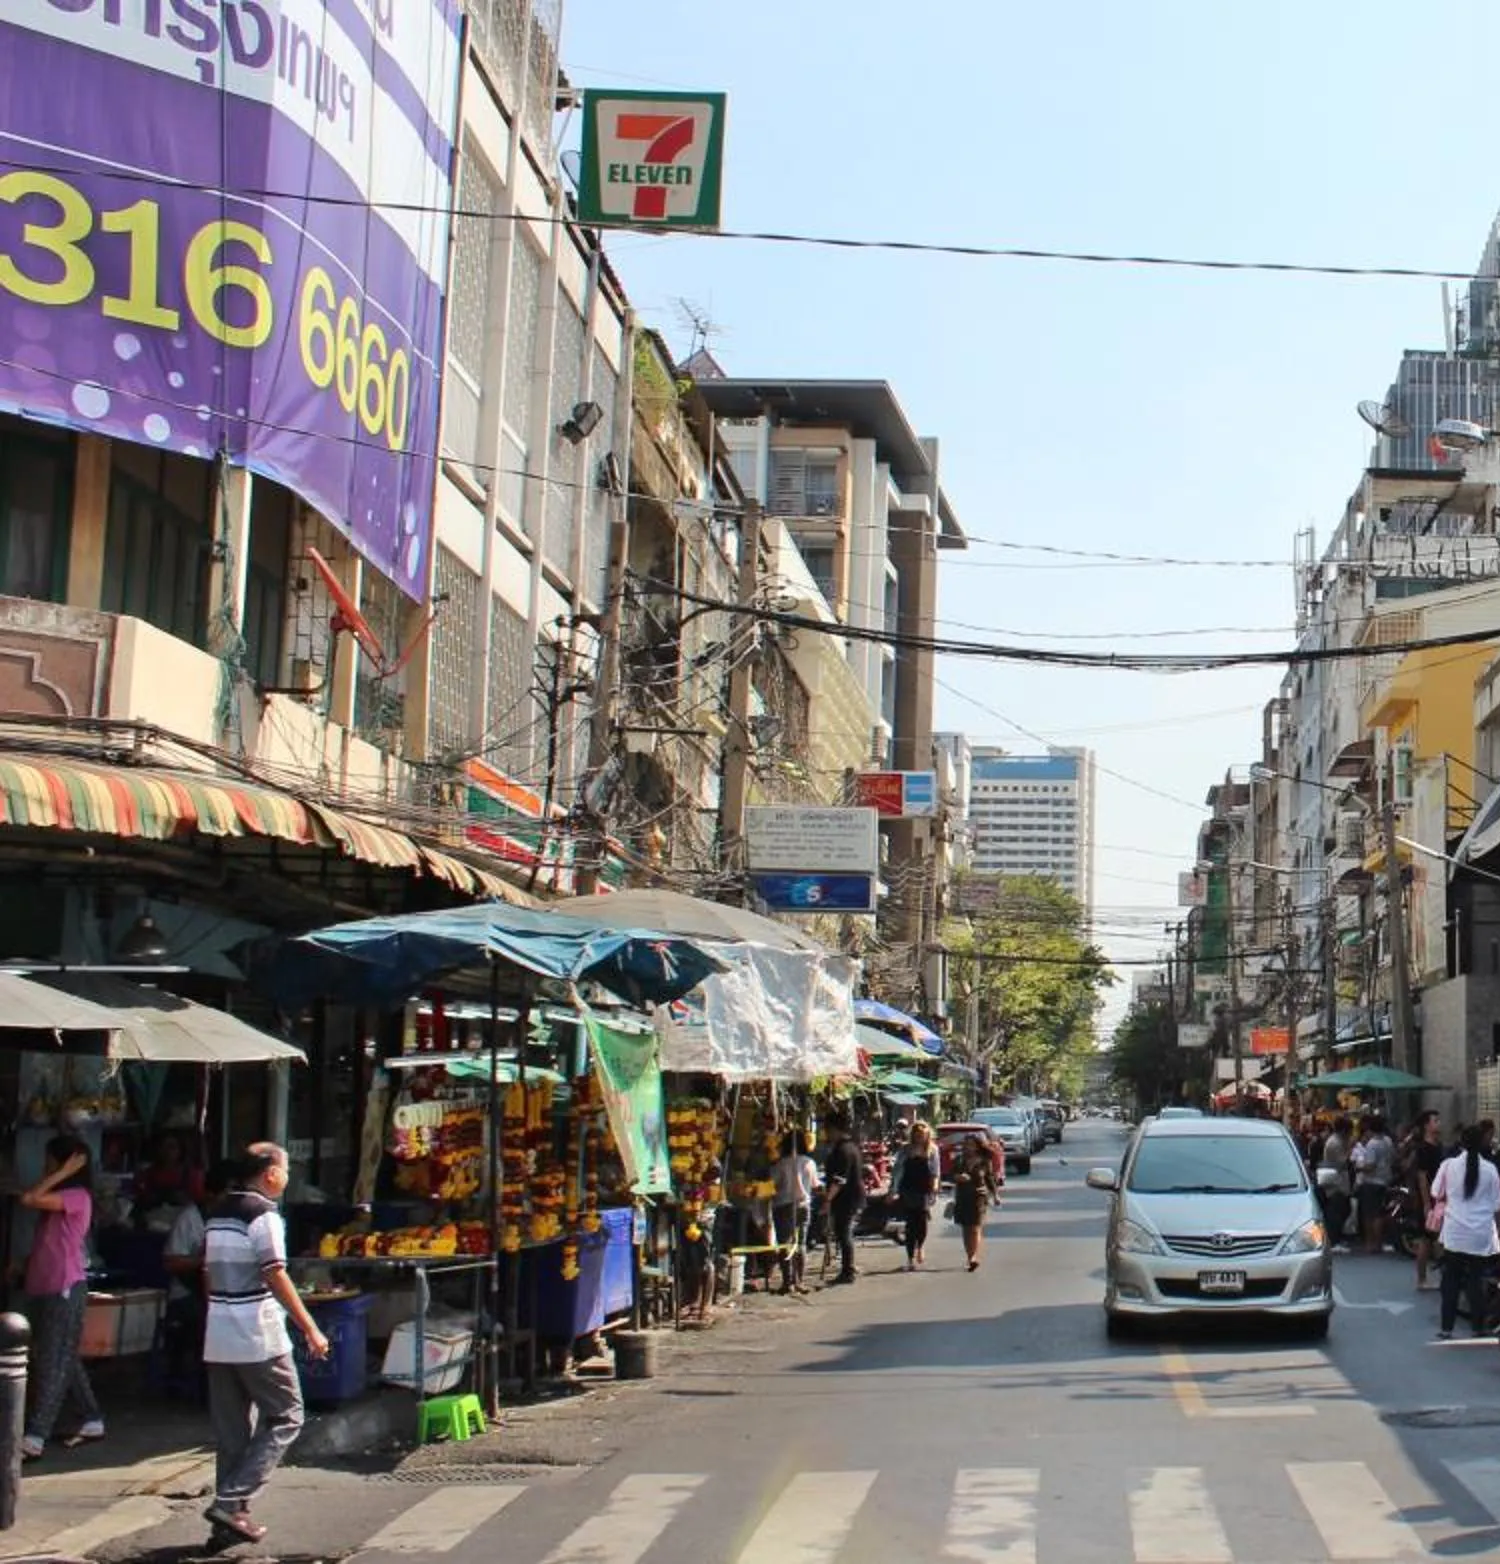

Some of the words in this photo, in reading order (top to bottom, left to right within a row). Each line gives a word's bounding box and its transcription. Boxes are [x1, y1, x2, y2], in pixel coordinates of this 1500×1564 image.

[616, 113, 695, 218] 7
[0, 171, 274, 348] 316
[299, 266, 409, 452] 6660
